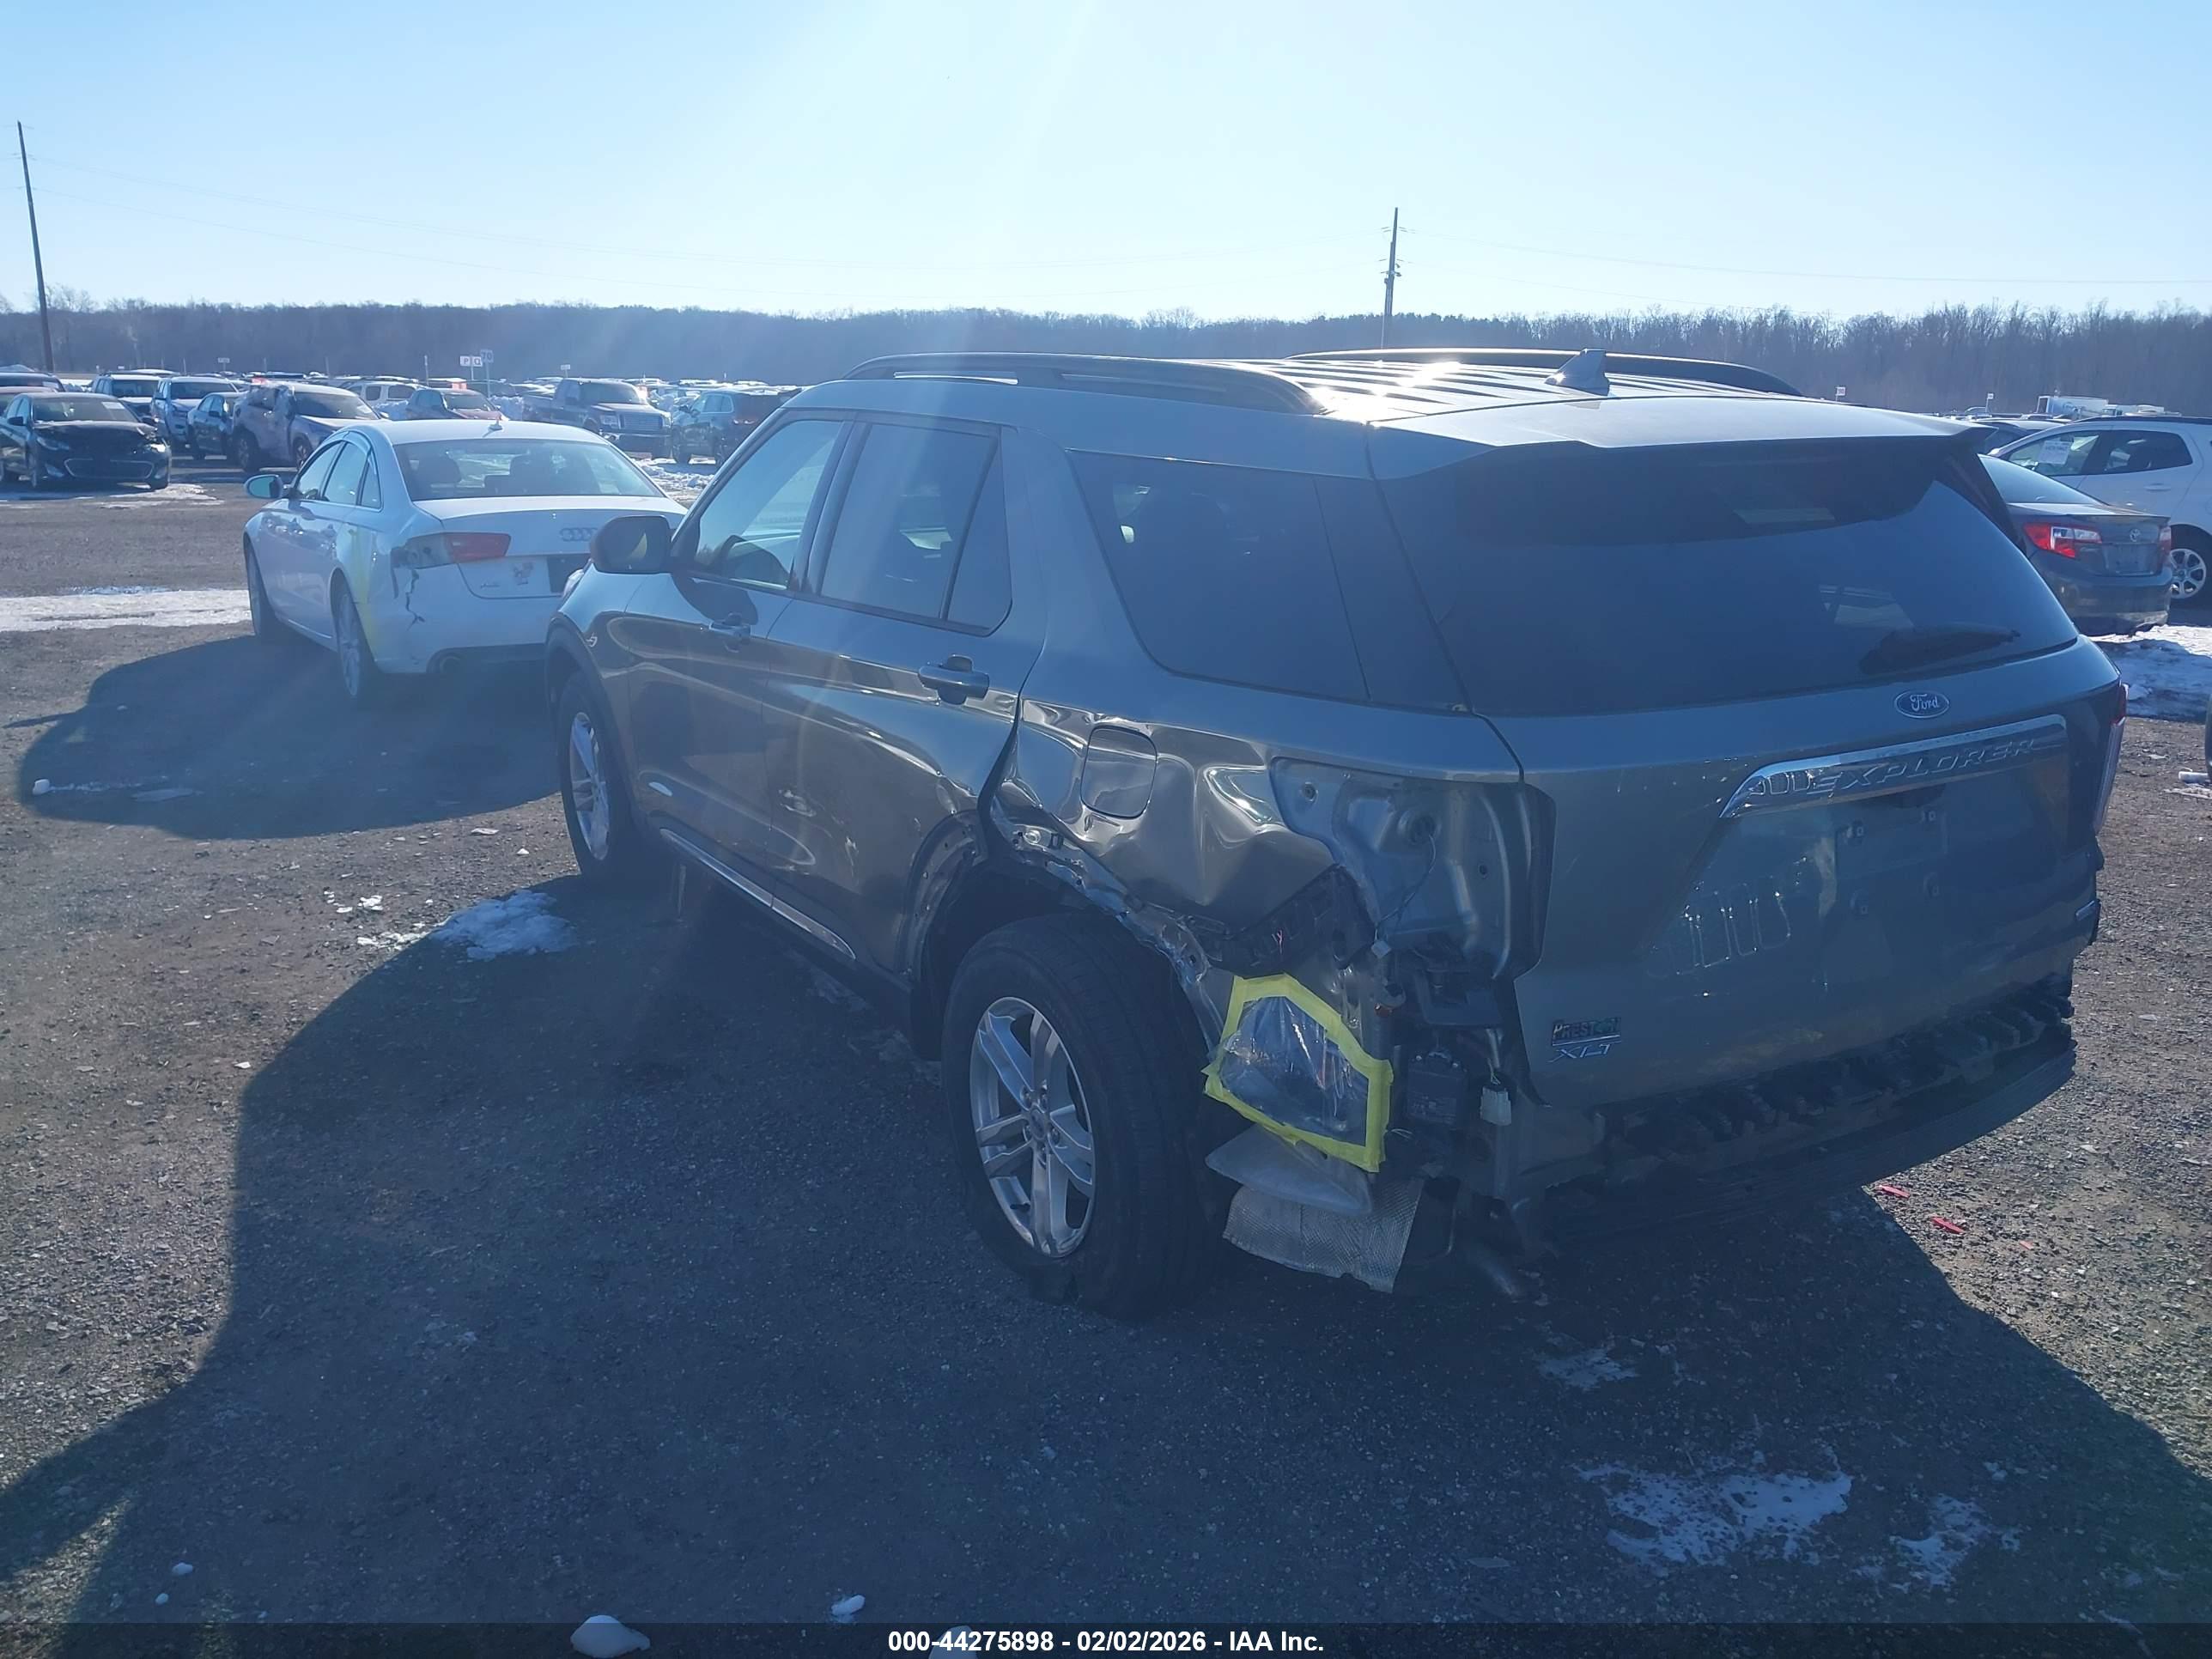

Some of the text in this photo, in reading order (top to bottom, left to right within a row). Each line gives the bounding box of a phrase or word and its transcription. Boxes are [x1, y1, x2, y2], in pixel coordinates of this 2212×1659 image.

[1910, 693, 1939, 711] Ford
[1808, 738, 2038, 794] EXPLORER
[1547, 1041, 1620, 1063] XLT
